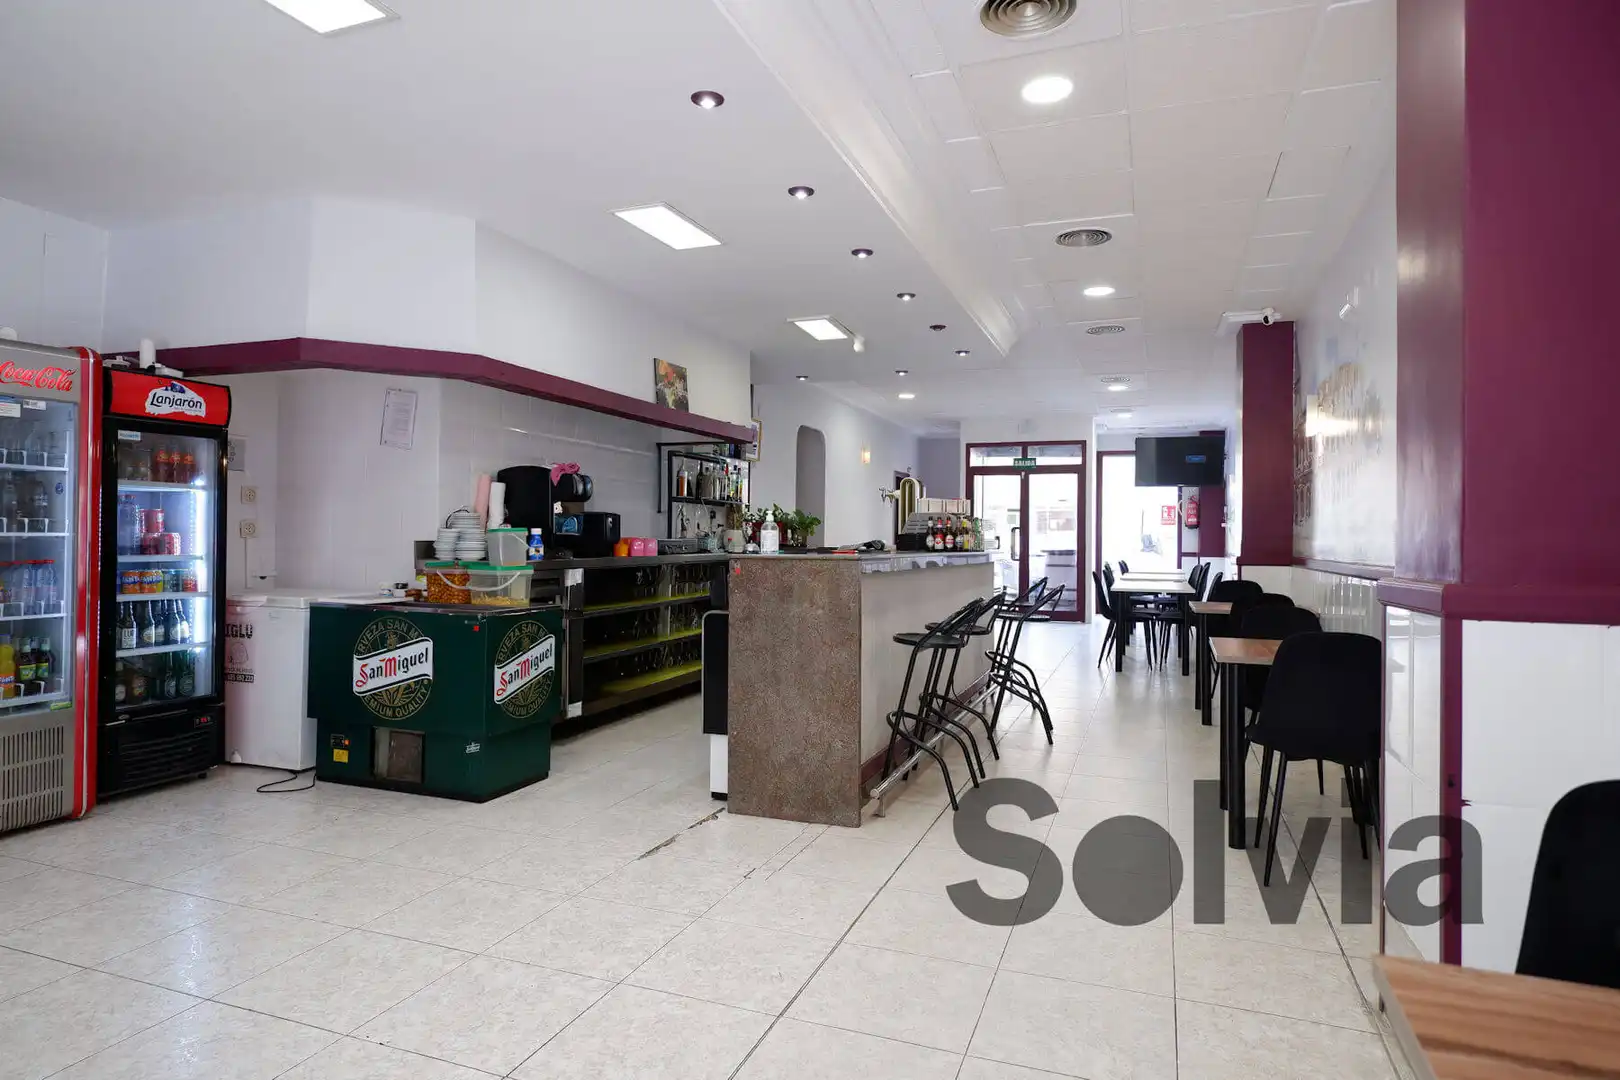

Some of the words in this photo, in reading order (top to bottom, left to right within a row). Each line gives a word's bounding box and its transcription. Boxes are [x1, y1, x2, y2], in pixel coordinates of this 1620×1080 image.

[150, 391, 203, 410] Lanjarón
[355, 622, 385, 654] RVEZA
[363, 695, 393, 718] EMIUM
